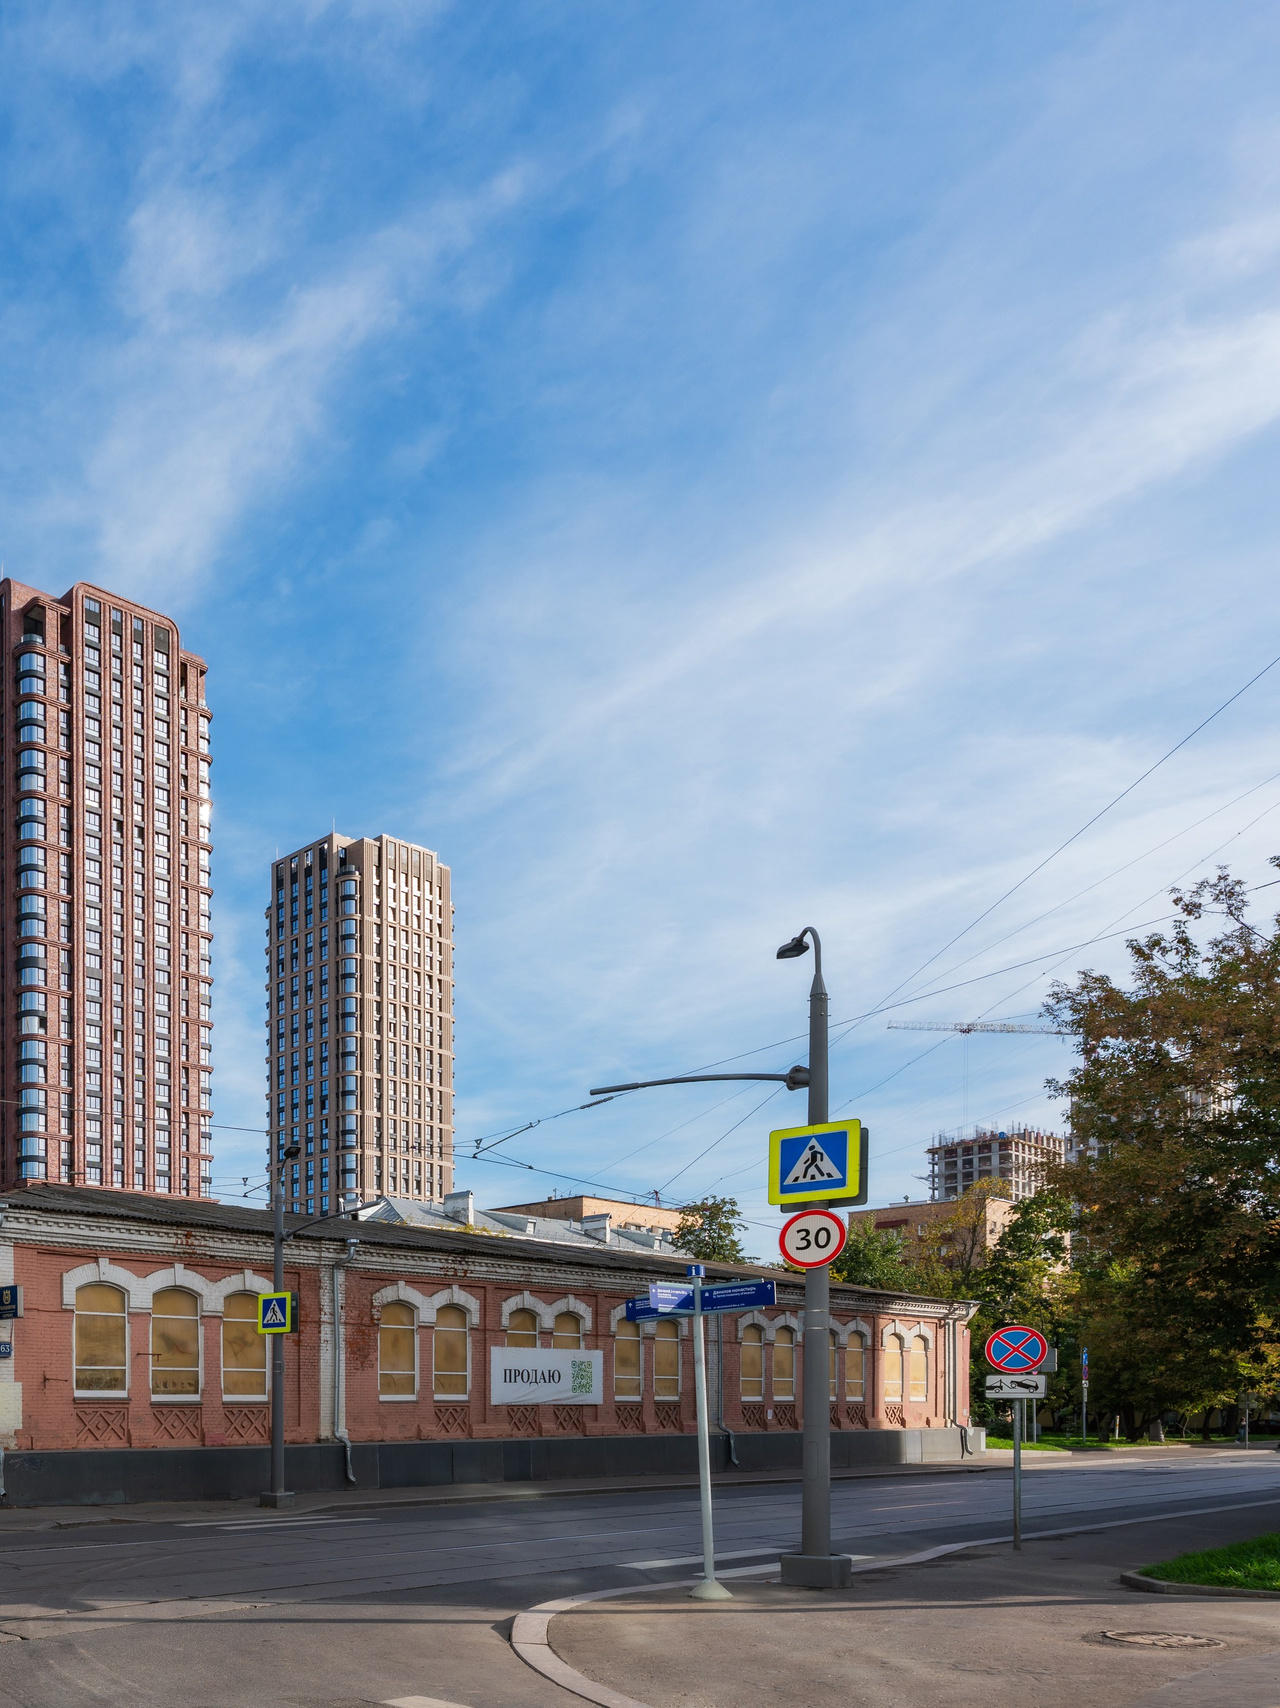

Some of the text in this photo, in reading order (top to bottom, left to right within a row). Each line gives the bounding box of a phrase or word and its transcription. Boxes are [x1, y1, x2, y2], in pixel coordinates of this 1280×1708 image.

[795, 1226, 831, 1251] 30
[0, 1344, 10, 1353] 63
[503, 1368, 561, 1387] ПРОДАЮ
